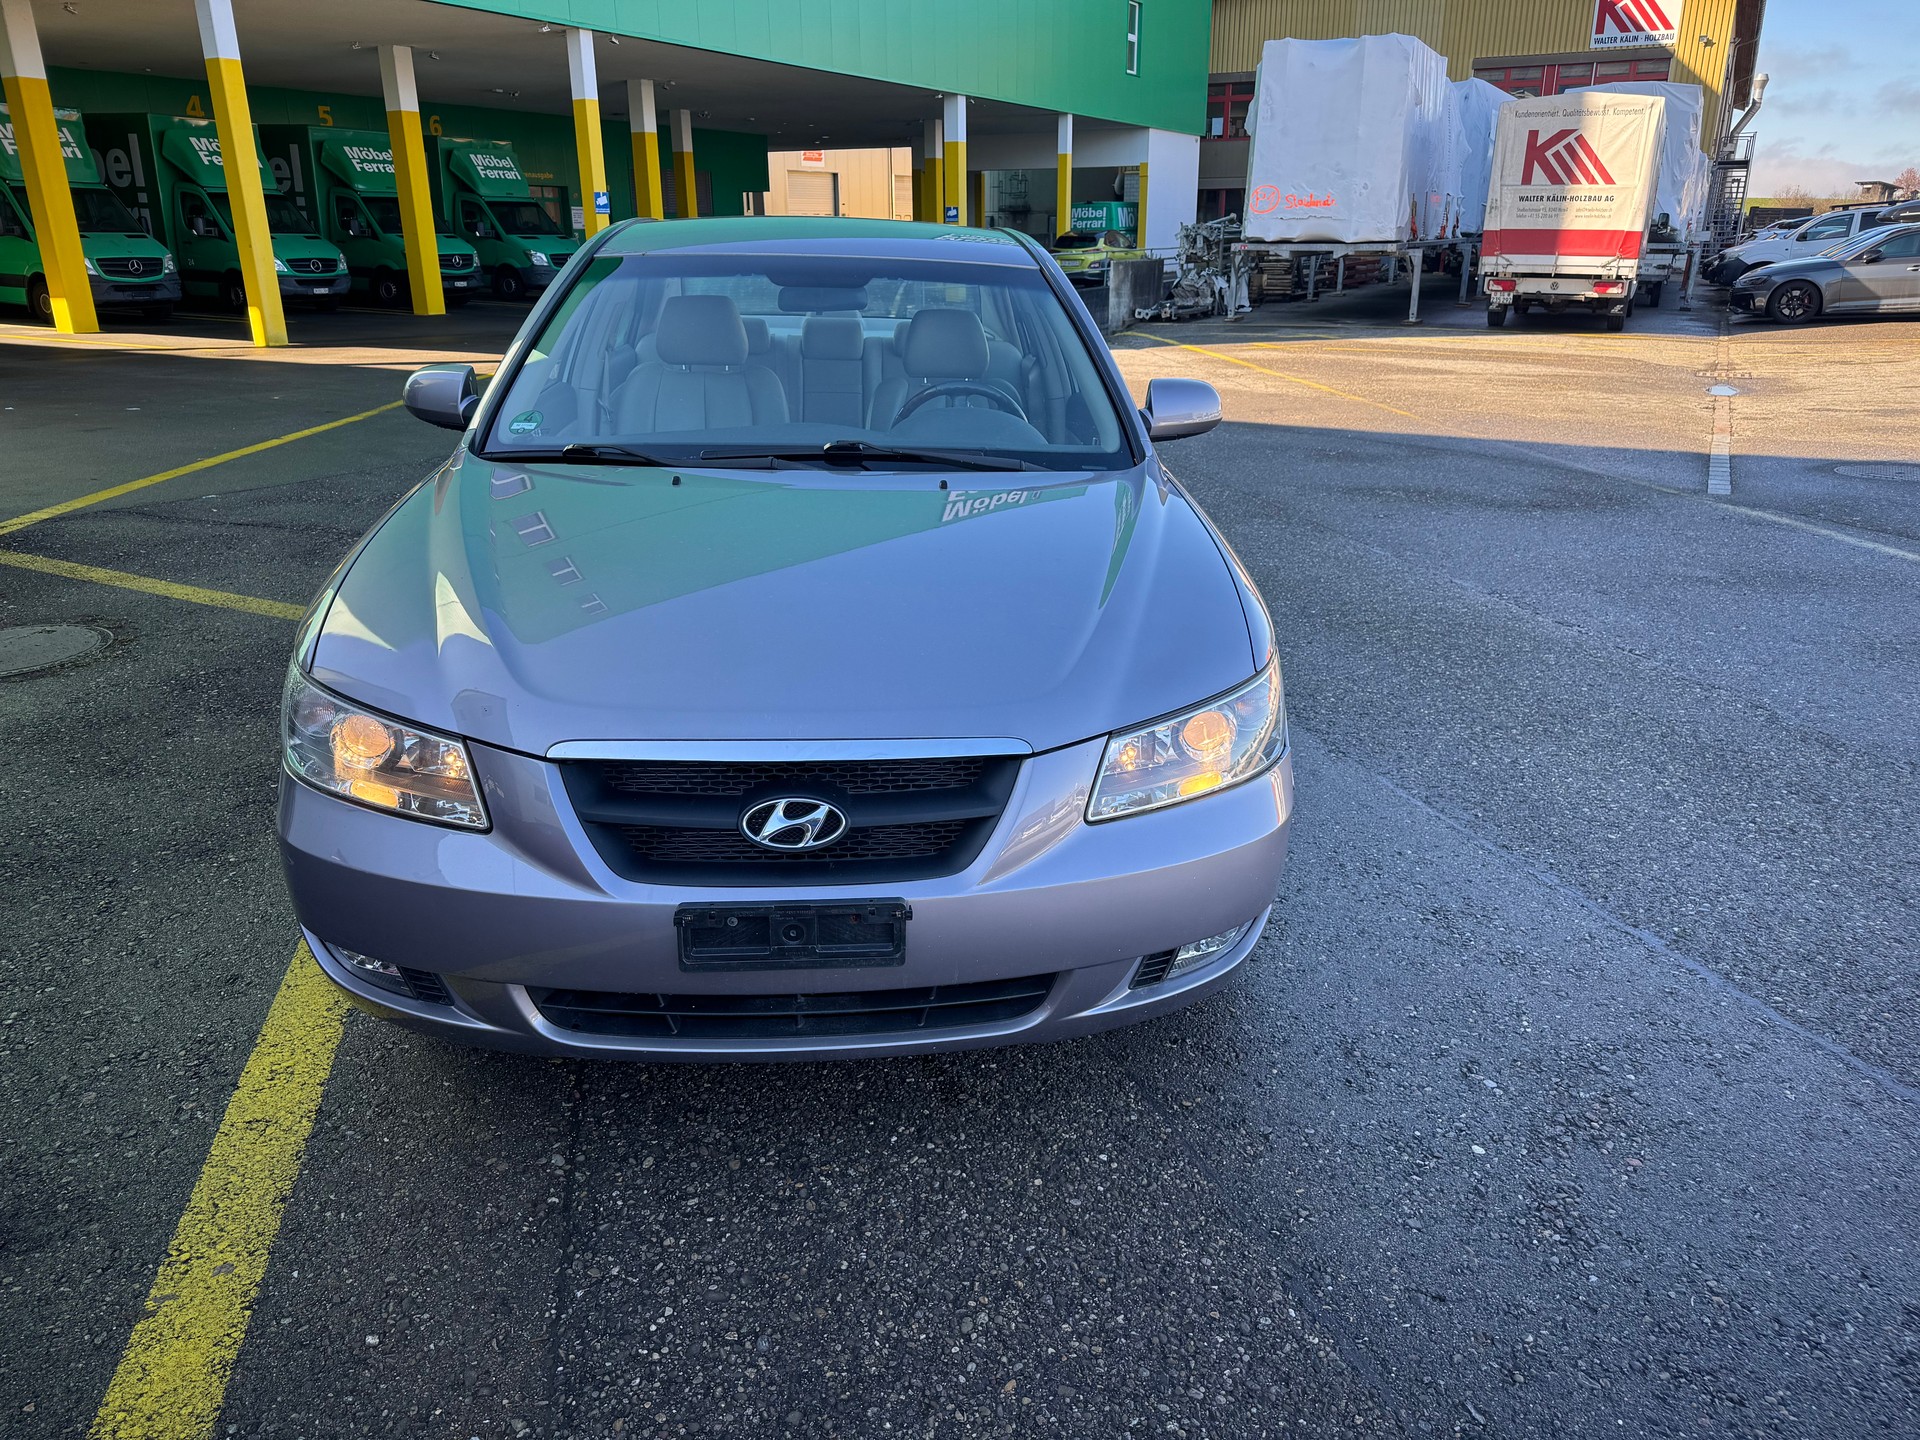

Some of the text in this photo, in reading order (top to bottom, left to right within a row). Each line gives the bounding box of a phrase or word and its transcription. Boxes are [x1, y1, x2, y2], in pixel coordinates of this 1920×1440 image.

[1594, 36, 1618, 44] WALTER
[1620, 34, 1639, 43] KÄLIN
[1644, 33, 1675, 42] HOLZBAU
[186, 95, 205, 116] 4
[317, 105, 334, 127] 5
[429, 115, 443, 136] 6
[350, 158, 395, 173] Ferra
[469, 153, 515, 168] Möbel
[476, 165, 522, 181] Ferrari
[1546, 193, 1602, 202] KÄLIN-HOLZBAU
[1071, 207, 1107, 218] Möbel
[1071, 217, 1106, 228] Ferrari
